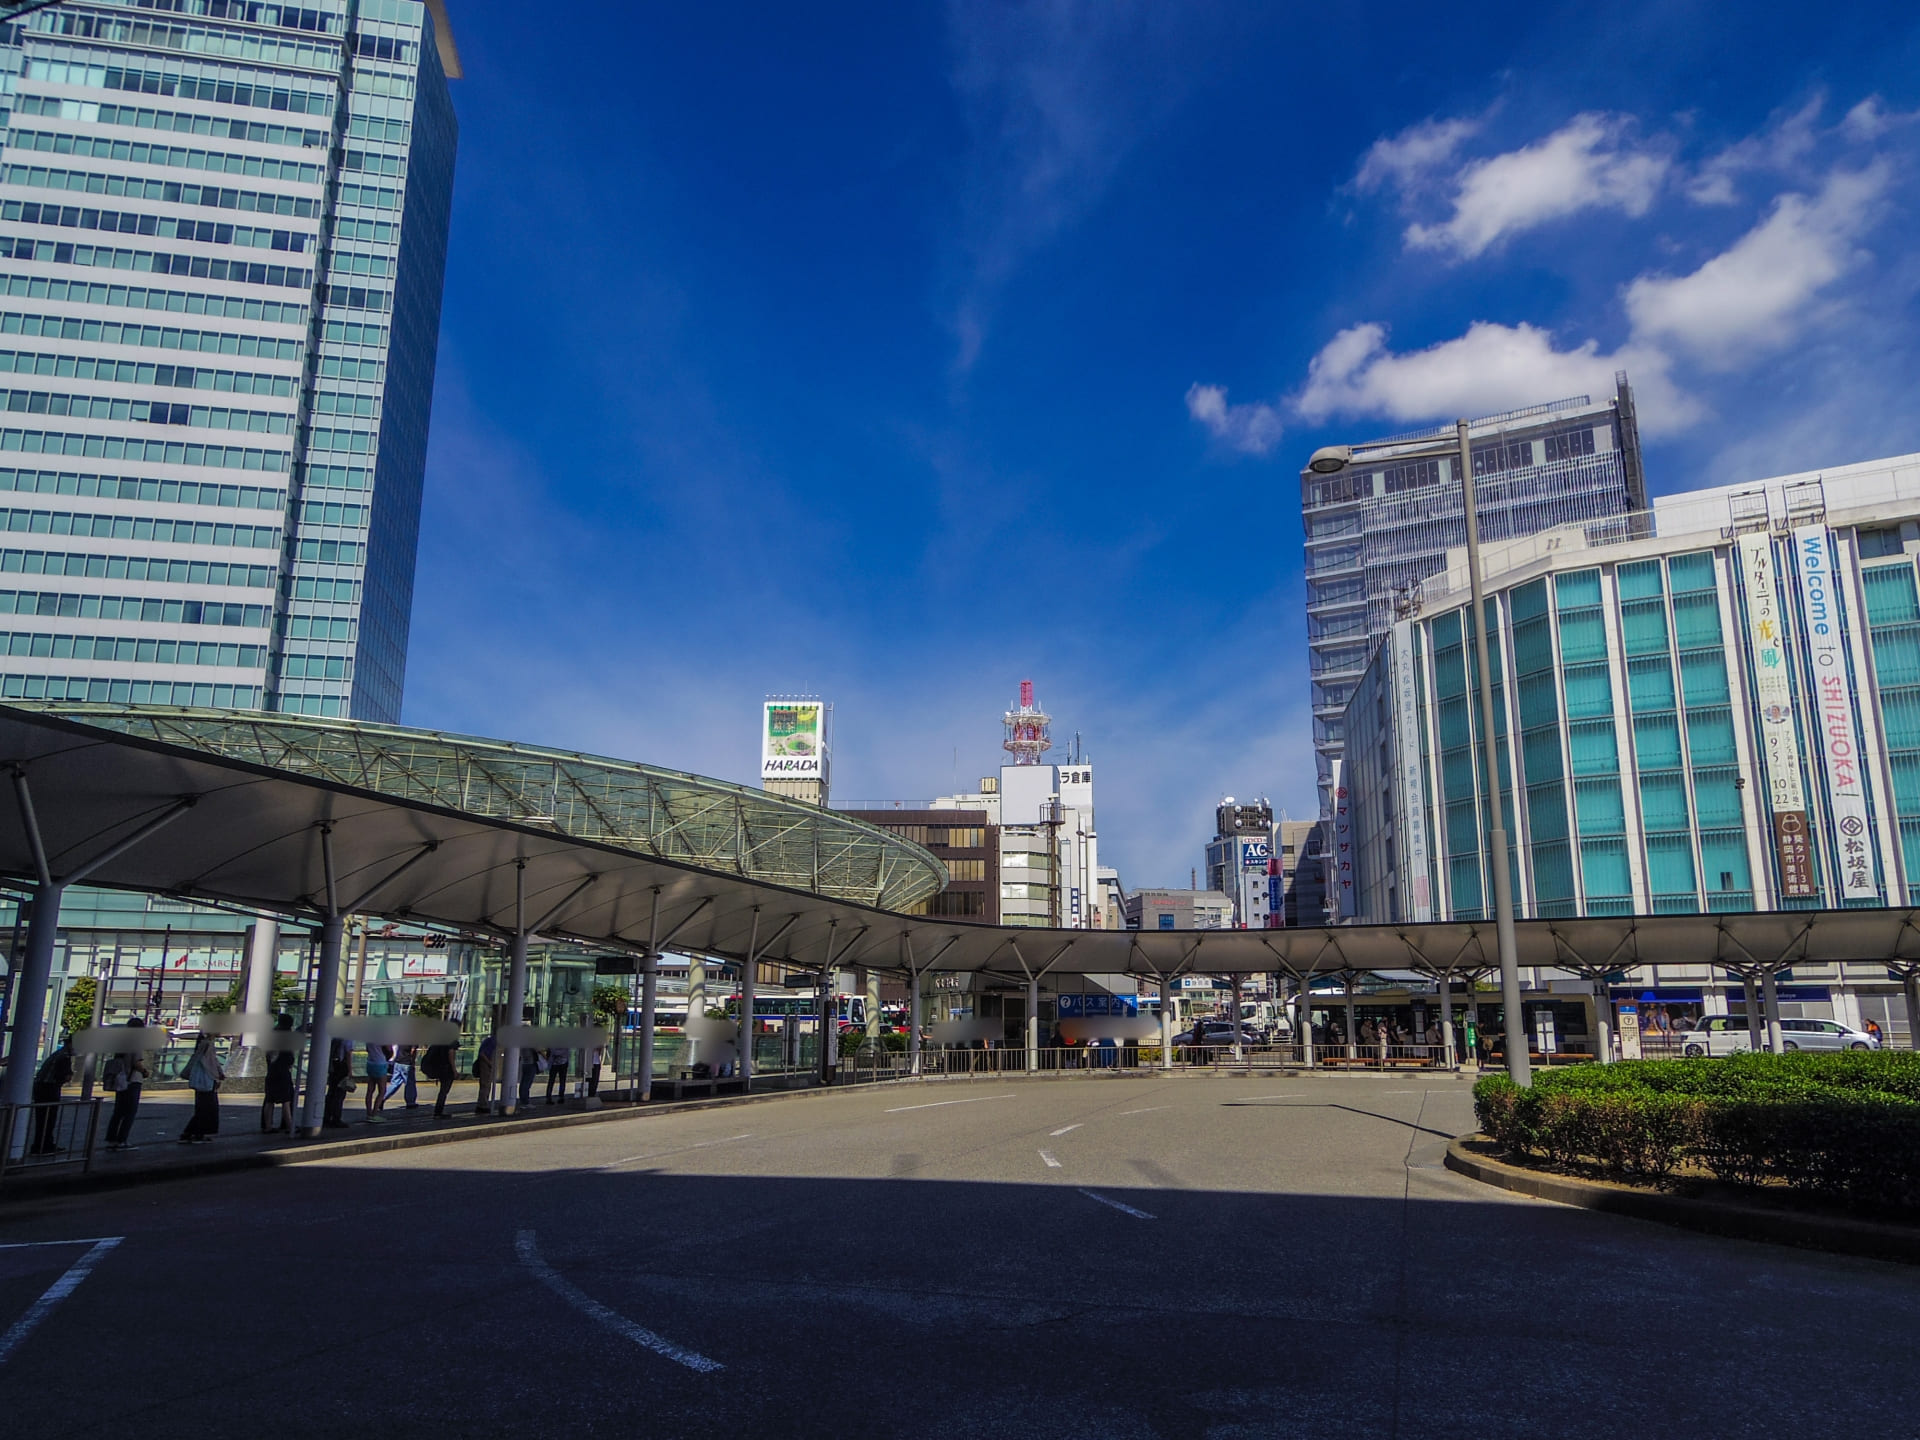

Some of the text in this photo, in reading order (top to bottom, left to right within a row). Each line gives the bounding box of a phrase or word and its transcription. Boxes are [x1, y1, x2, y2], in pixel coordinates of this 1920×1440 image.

[1803, 537, 1859, 797] Welcome to SHIZUOKA!
[1770, 737, 1778, 748] 9
[1773, 752, 1779, 762] 5
[764, 759, 818, 771] HARADA
[1059, 771, 1092, 783] ラ倉庫
[1774, 778, 1787, 789] 10
[1775, 793, 1789, 804] 22
[1337, 807, 1351, 889] マツザカヤ
[1844, 837, 1870, 889] 松坂屋
